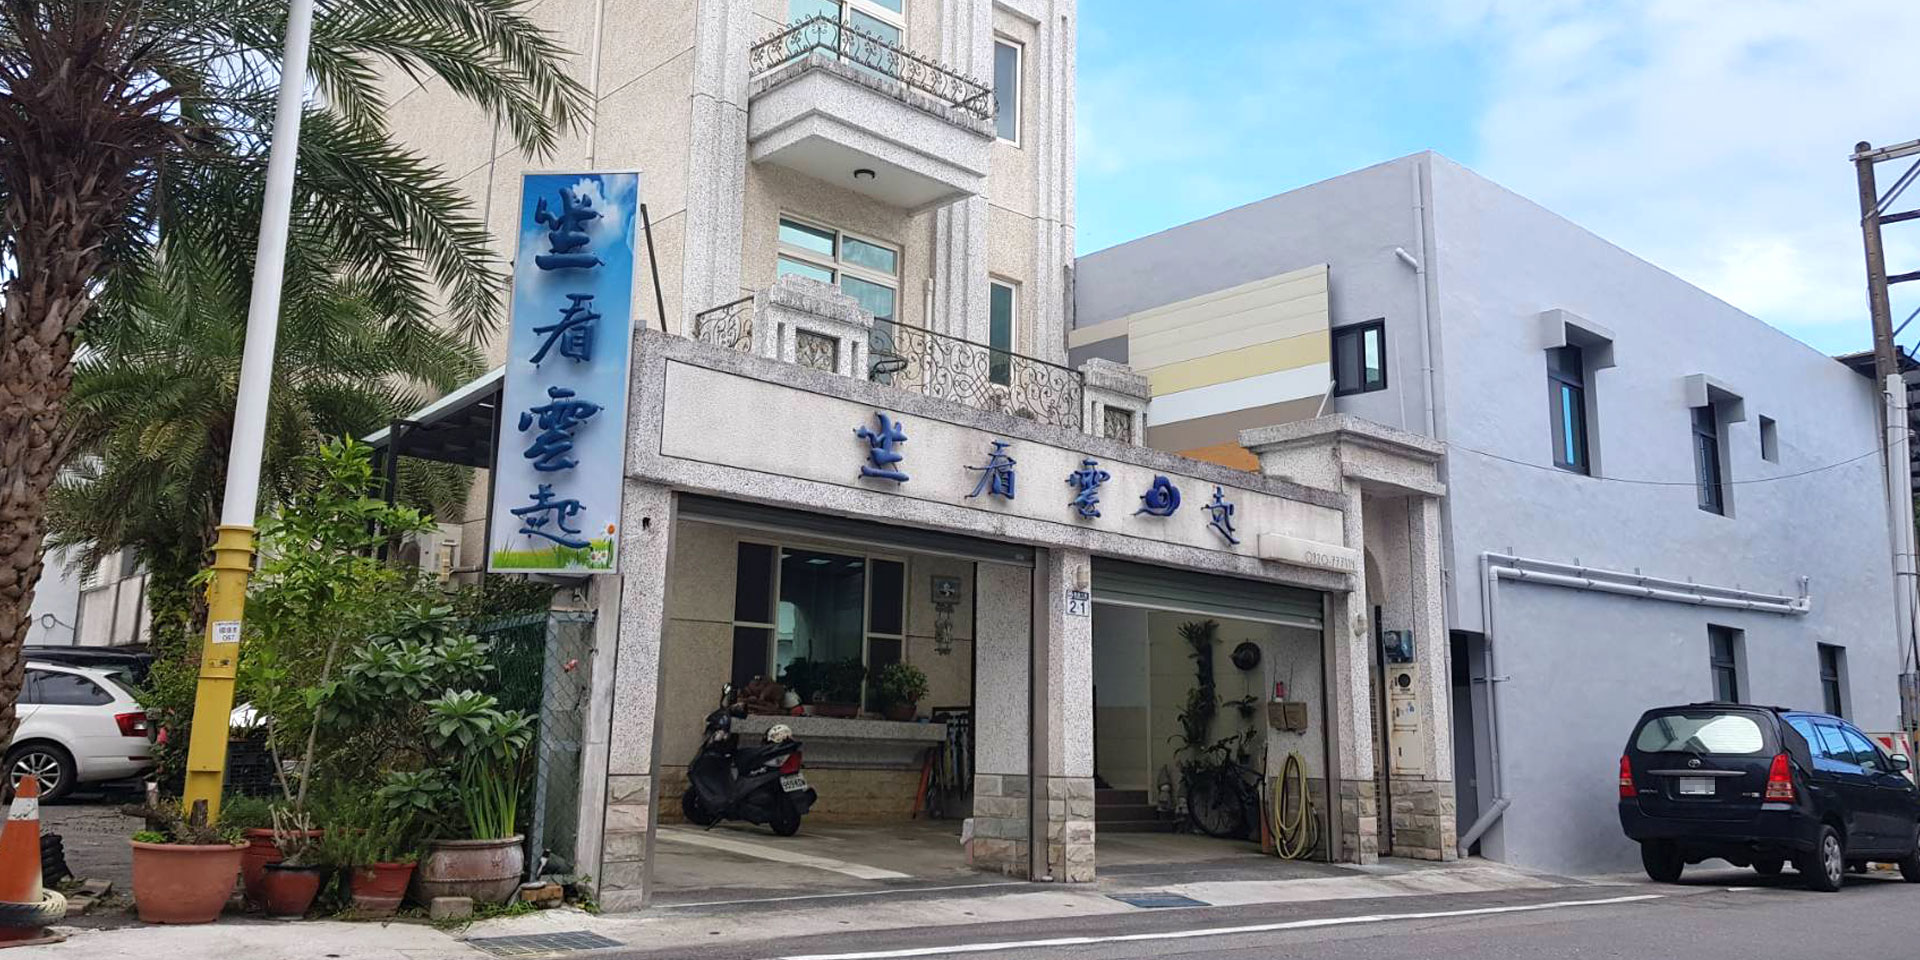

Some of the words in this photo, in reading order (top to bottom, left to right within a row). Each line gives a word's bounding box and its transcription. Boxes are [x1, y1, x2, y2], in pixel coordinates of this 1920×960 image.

[511, 187, 605, 549] 坐看雲起
[1069, 600, 1085, 614] 21
